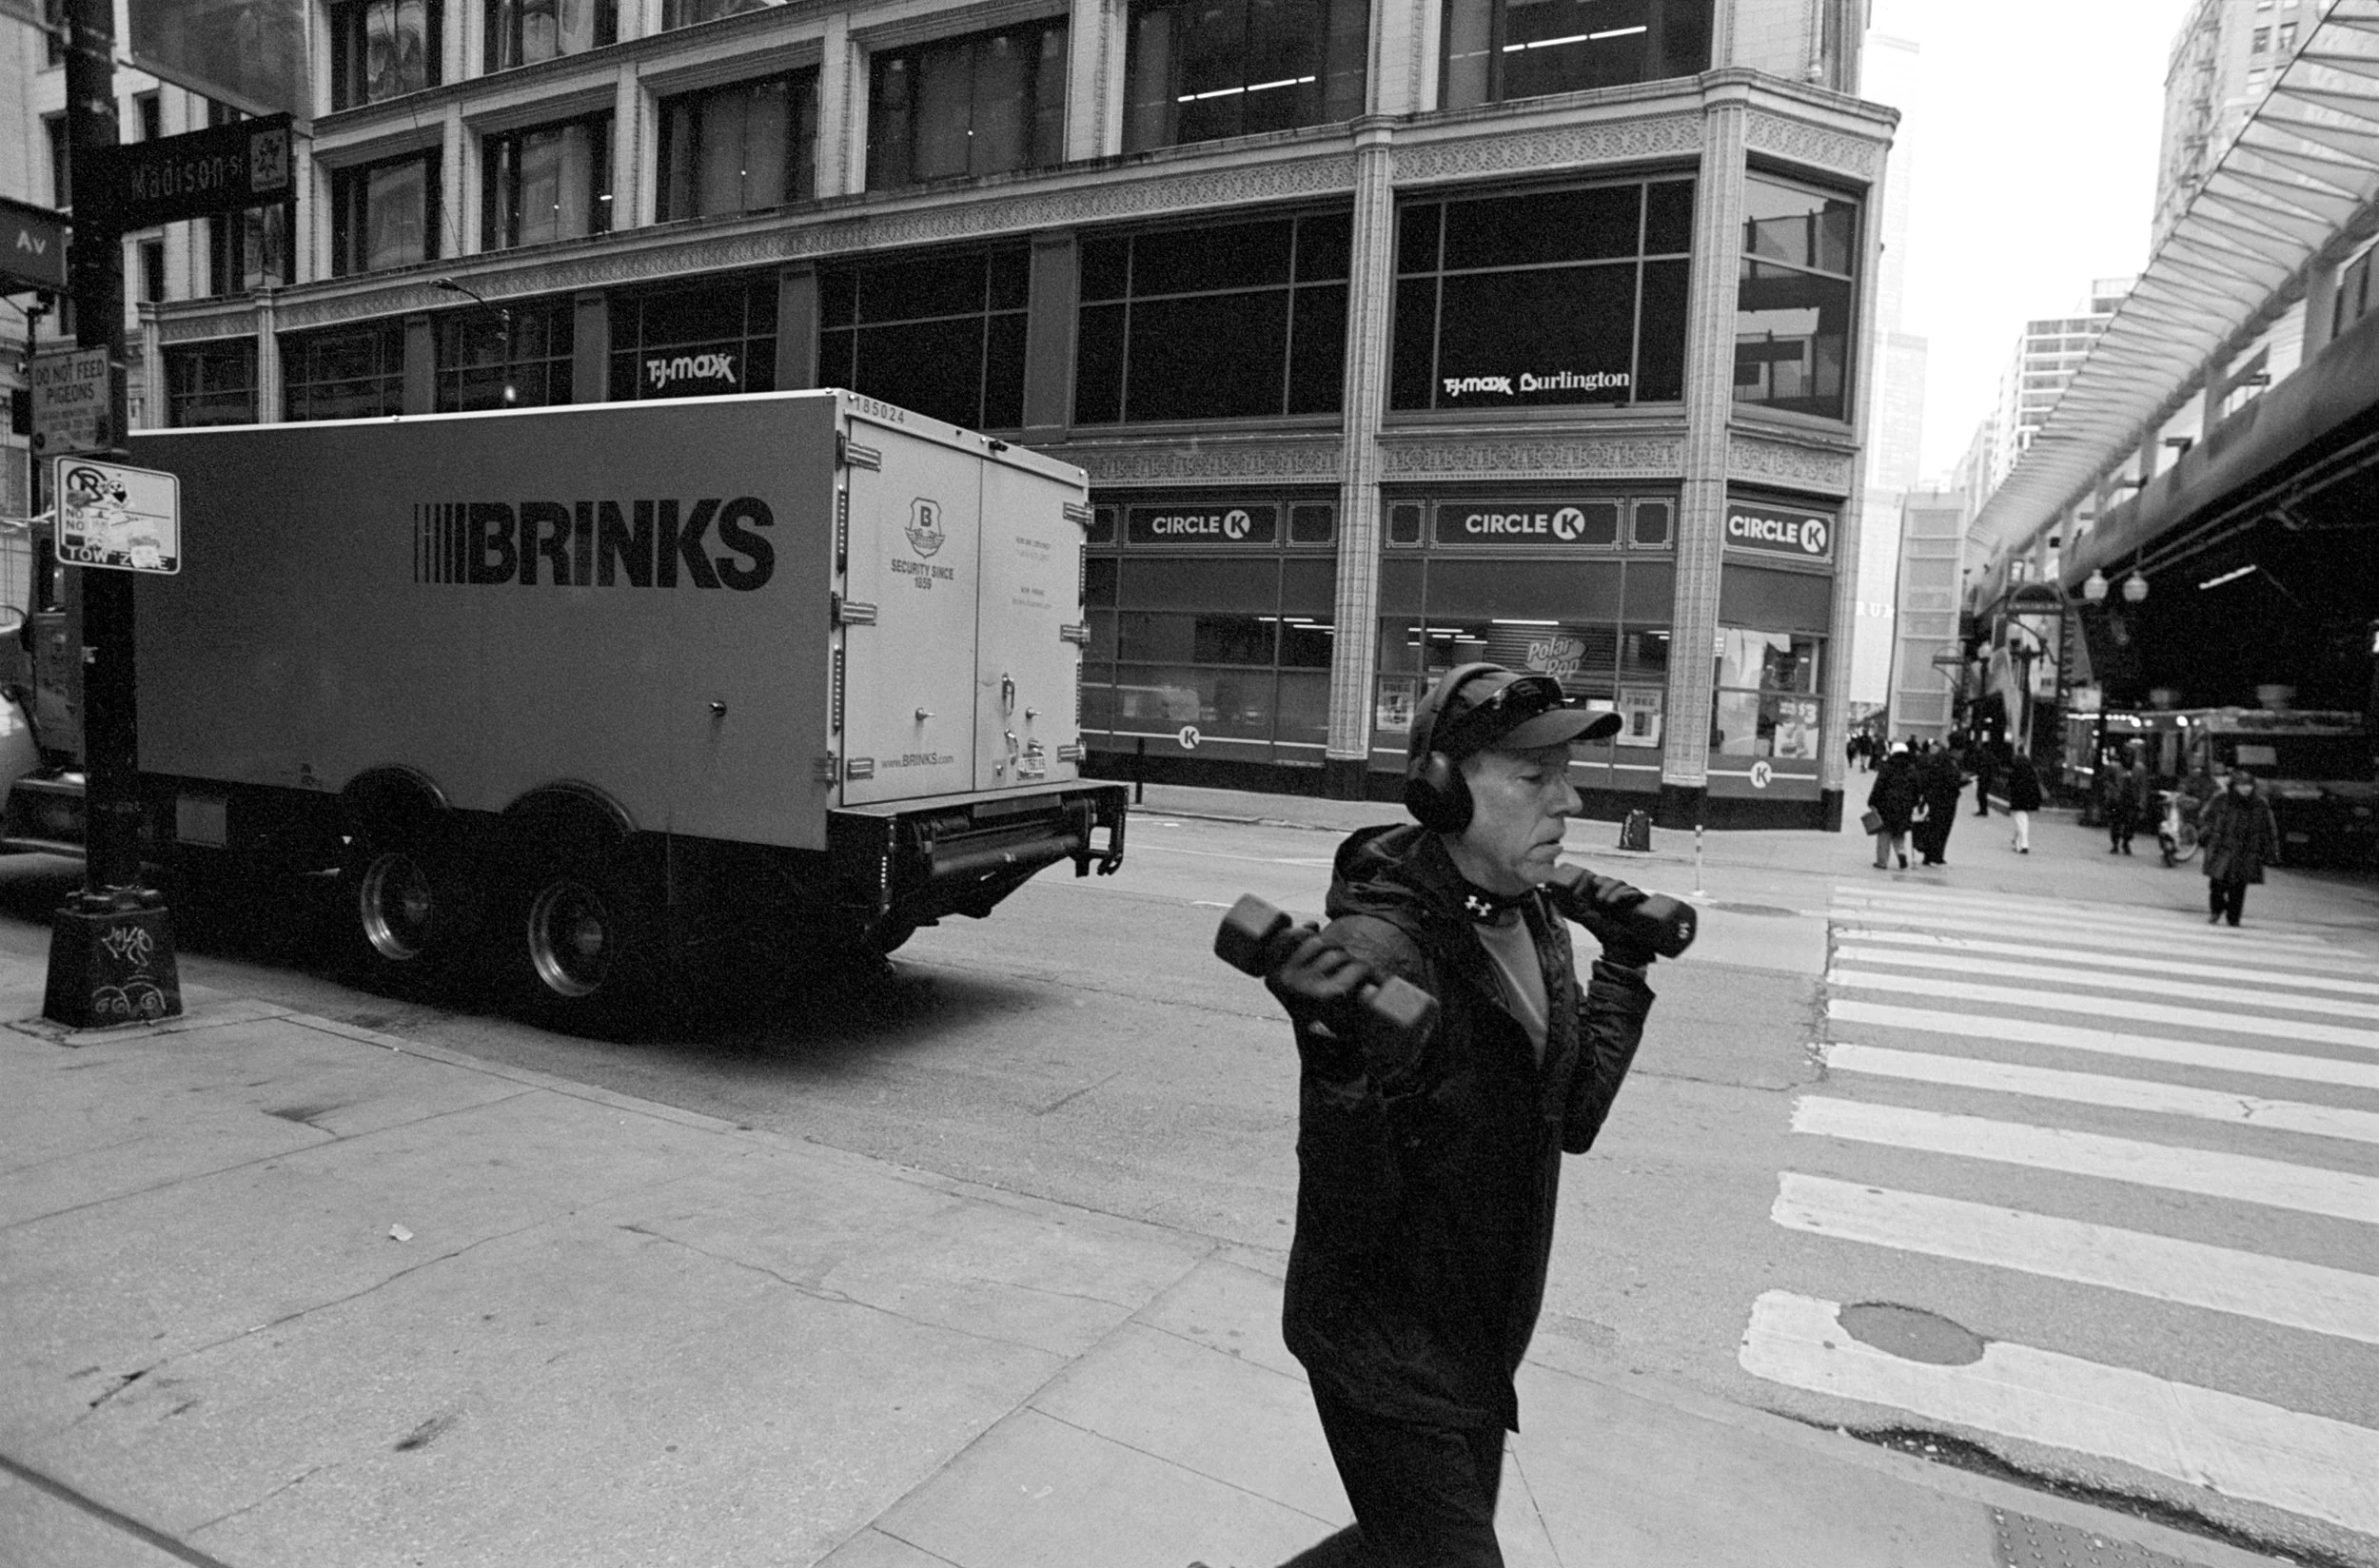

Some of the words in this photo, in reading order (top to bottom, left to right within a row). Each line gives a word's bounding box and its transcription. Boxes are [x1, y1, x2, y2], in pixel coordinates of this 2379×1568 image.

[131, 156, 225, 200] Madison
[16, 230, 46, 254] Av
[35, 366, 50, 386] DO
[52, 363, 73, 383] NOT
[76, 359, 105, 380] FEED
[1520, 371, 1630, 391] Burlington
[46, 382, 95, 404] PIGEONS
[66, 508, 84, 519] NO
[920, 505, 933, 527] B
[1465, 514, 1548, 534] CIRCLE
[66, 520, 85, 531] NO
[1151, 516, 1221, 534] CIRCLE
[1729, 515, 1799, 543] CIRCLE
[468, 497, 776, 592] BRINKS
[68, 546, 108, 563] TOW
[119, 553, 168, 570] ZE
[891, 558, 930, 576] SECURITY
[932, 565, 954, 580] SINCE
[1526, 637, 1573, 663] Polar
[1544, 657, 1581, 679] Pop
[1626, 696, 1656, 706] FREE
[880, 753, 954, 769] www.BRINKS.com
